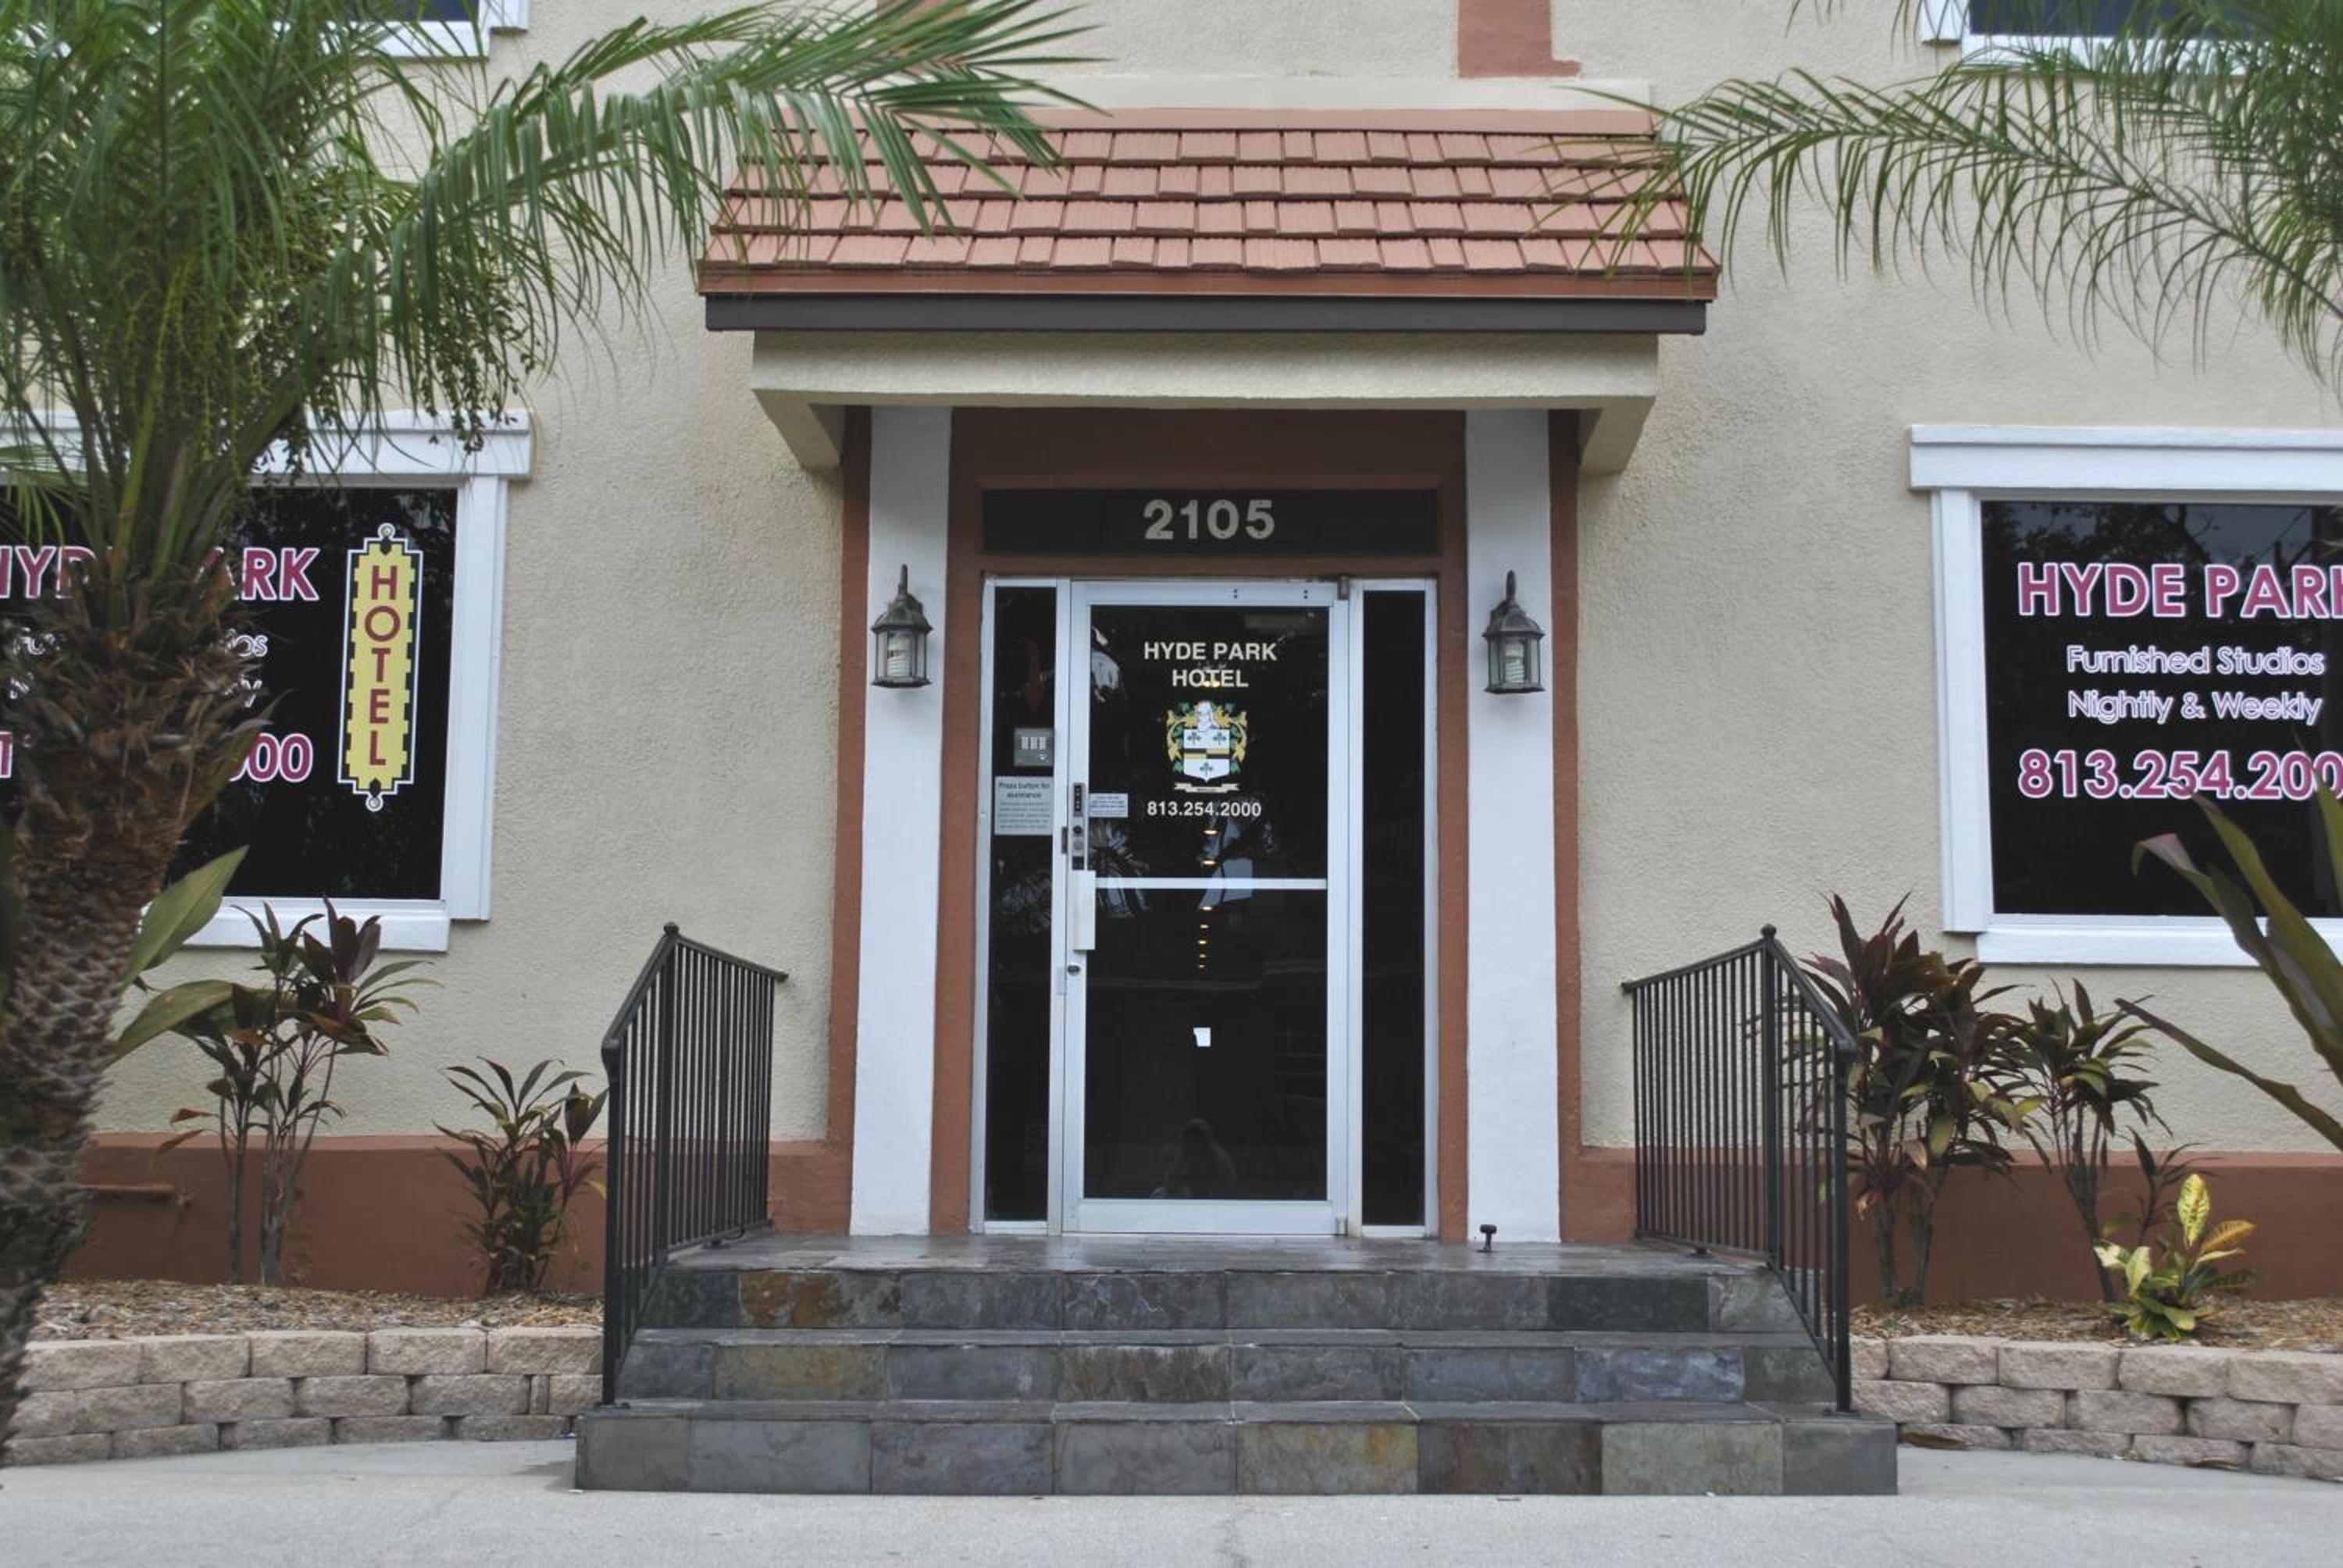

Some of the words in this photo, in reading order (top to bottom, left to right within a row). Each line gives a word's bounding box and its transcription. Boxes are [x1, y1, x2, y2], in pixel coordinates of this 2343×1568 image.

[1143, 498, 1275, 540] 2105
[2017, 561, 2187, 618] HYDE
[364, 565, 401, 766] HOTEL
[1143, 642, 1207, 660] HYDE
[1213, 643, 1278, 661] PARK
[2066, 645, 2210, 675] Furnished
[2216, 646, 2326, 675] Studios
[1172, 669, 1249, 688] HOTEL
[2067, 690, 2174, 725] Nightly
[2180, 692, 2206, 720] &
[2211, 691, 2323, 725] Weekly
[1147, 801, 1262, 817] 813.254.2000
